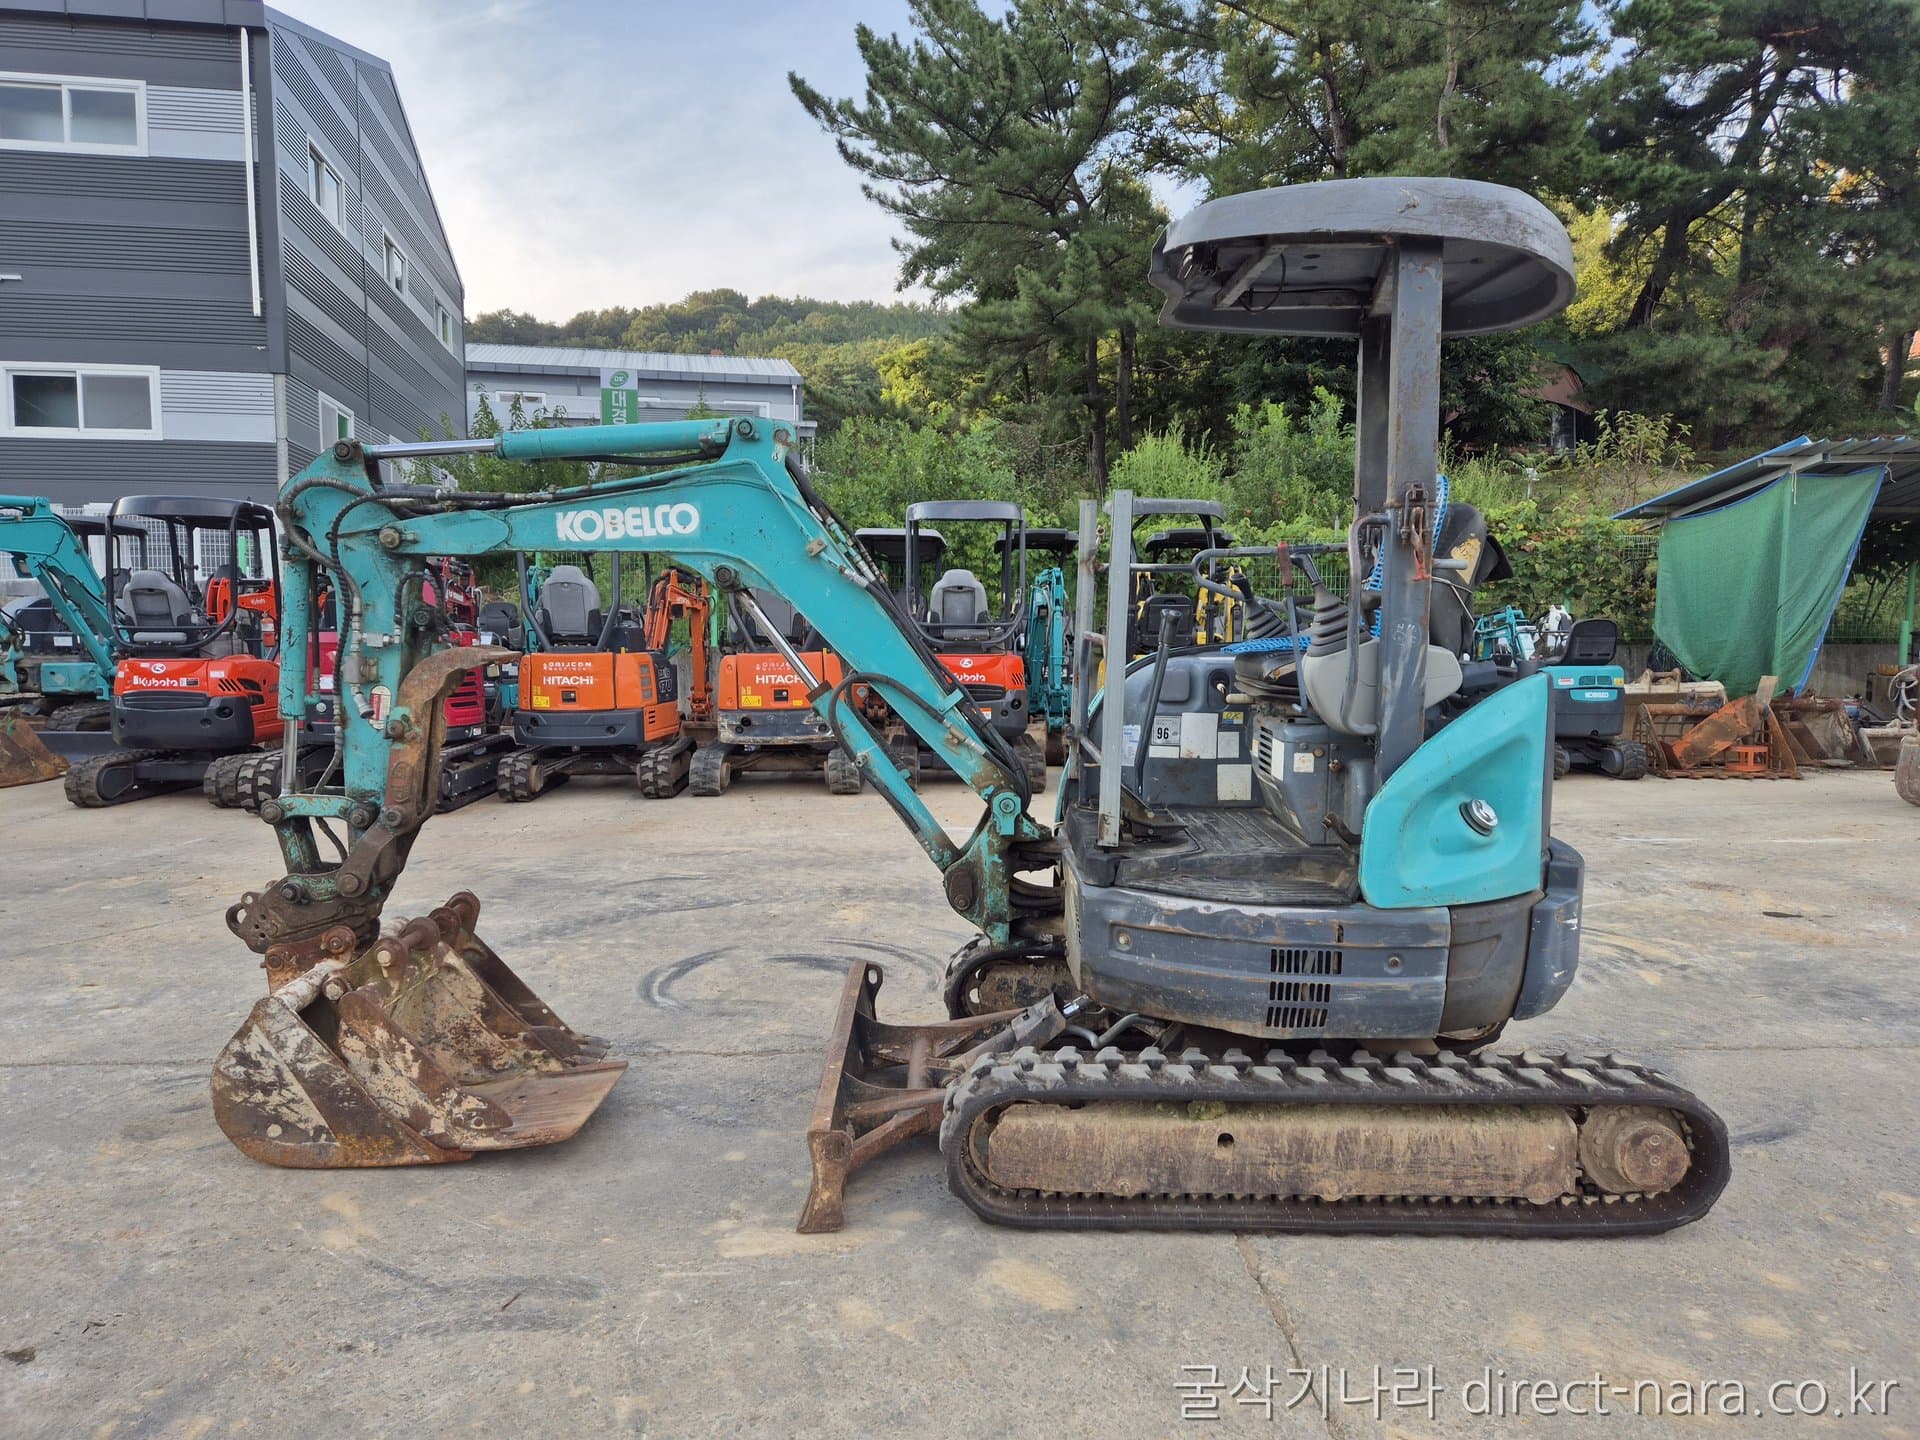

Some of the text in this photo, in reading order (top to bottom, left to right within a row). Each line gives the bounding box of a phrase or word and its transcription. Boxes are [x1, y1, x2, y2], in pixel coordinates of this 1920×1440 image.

[611, 390, 627, 424] 대경
[555, 502, 700, 542] KOBELCO
[139, 678, 178, 687] Kubota
[543, 675, 594, 685] HITACHI
[755, 674, 803, 684] HITACH
[1157, 727, 1169, 740] 96
